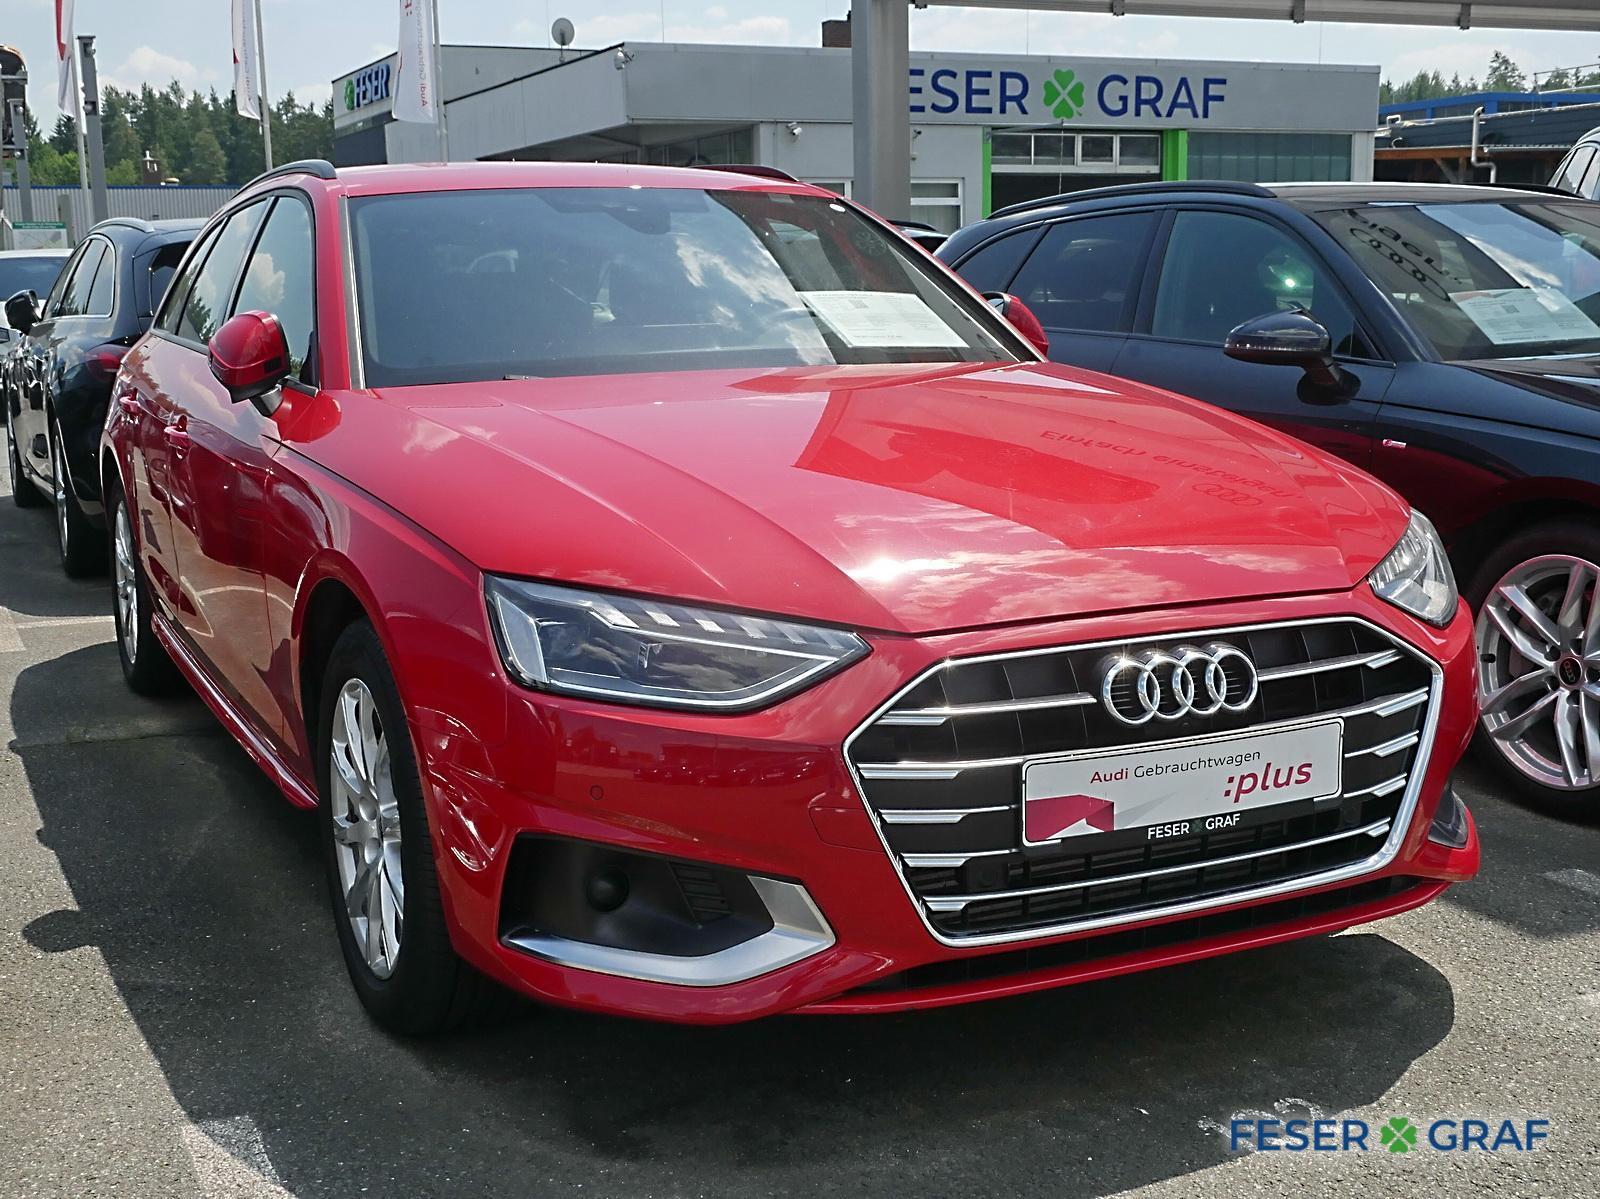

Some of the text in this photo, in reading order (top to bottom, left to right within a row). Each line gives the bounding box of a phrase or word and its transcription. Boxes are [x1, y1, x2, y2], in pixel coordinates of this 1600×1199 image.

[354, 63, 390, 108] FESER
[909, 68, 1227, 119] ESER GRAF
[1090, 750, 1261, 784] Audi Gebrauchtwagen
[1223, 762, 1313, 804] :plus
[1147, 814, 1241, 840] FESER GRAF
